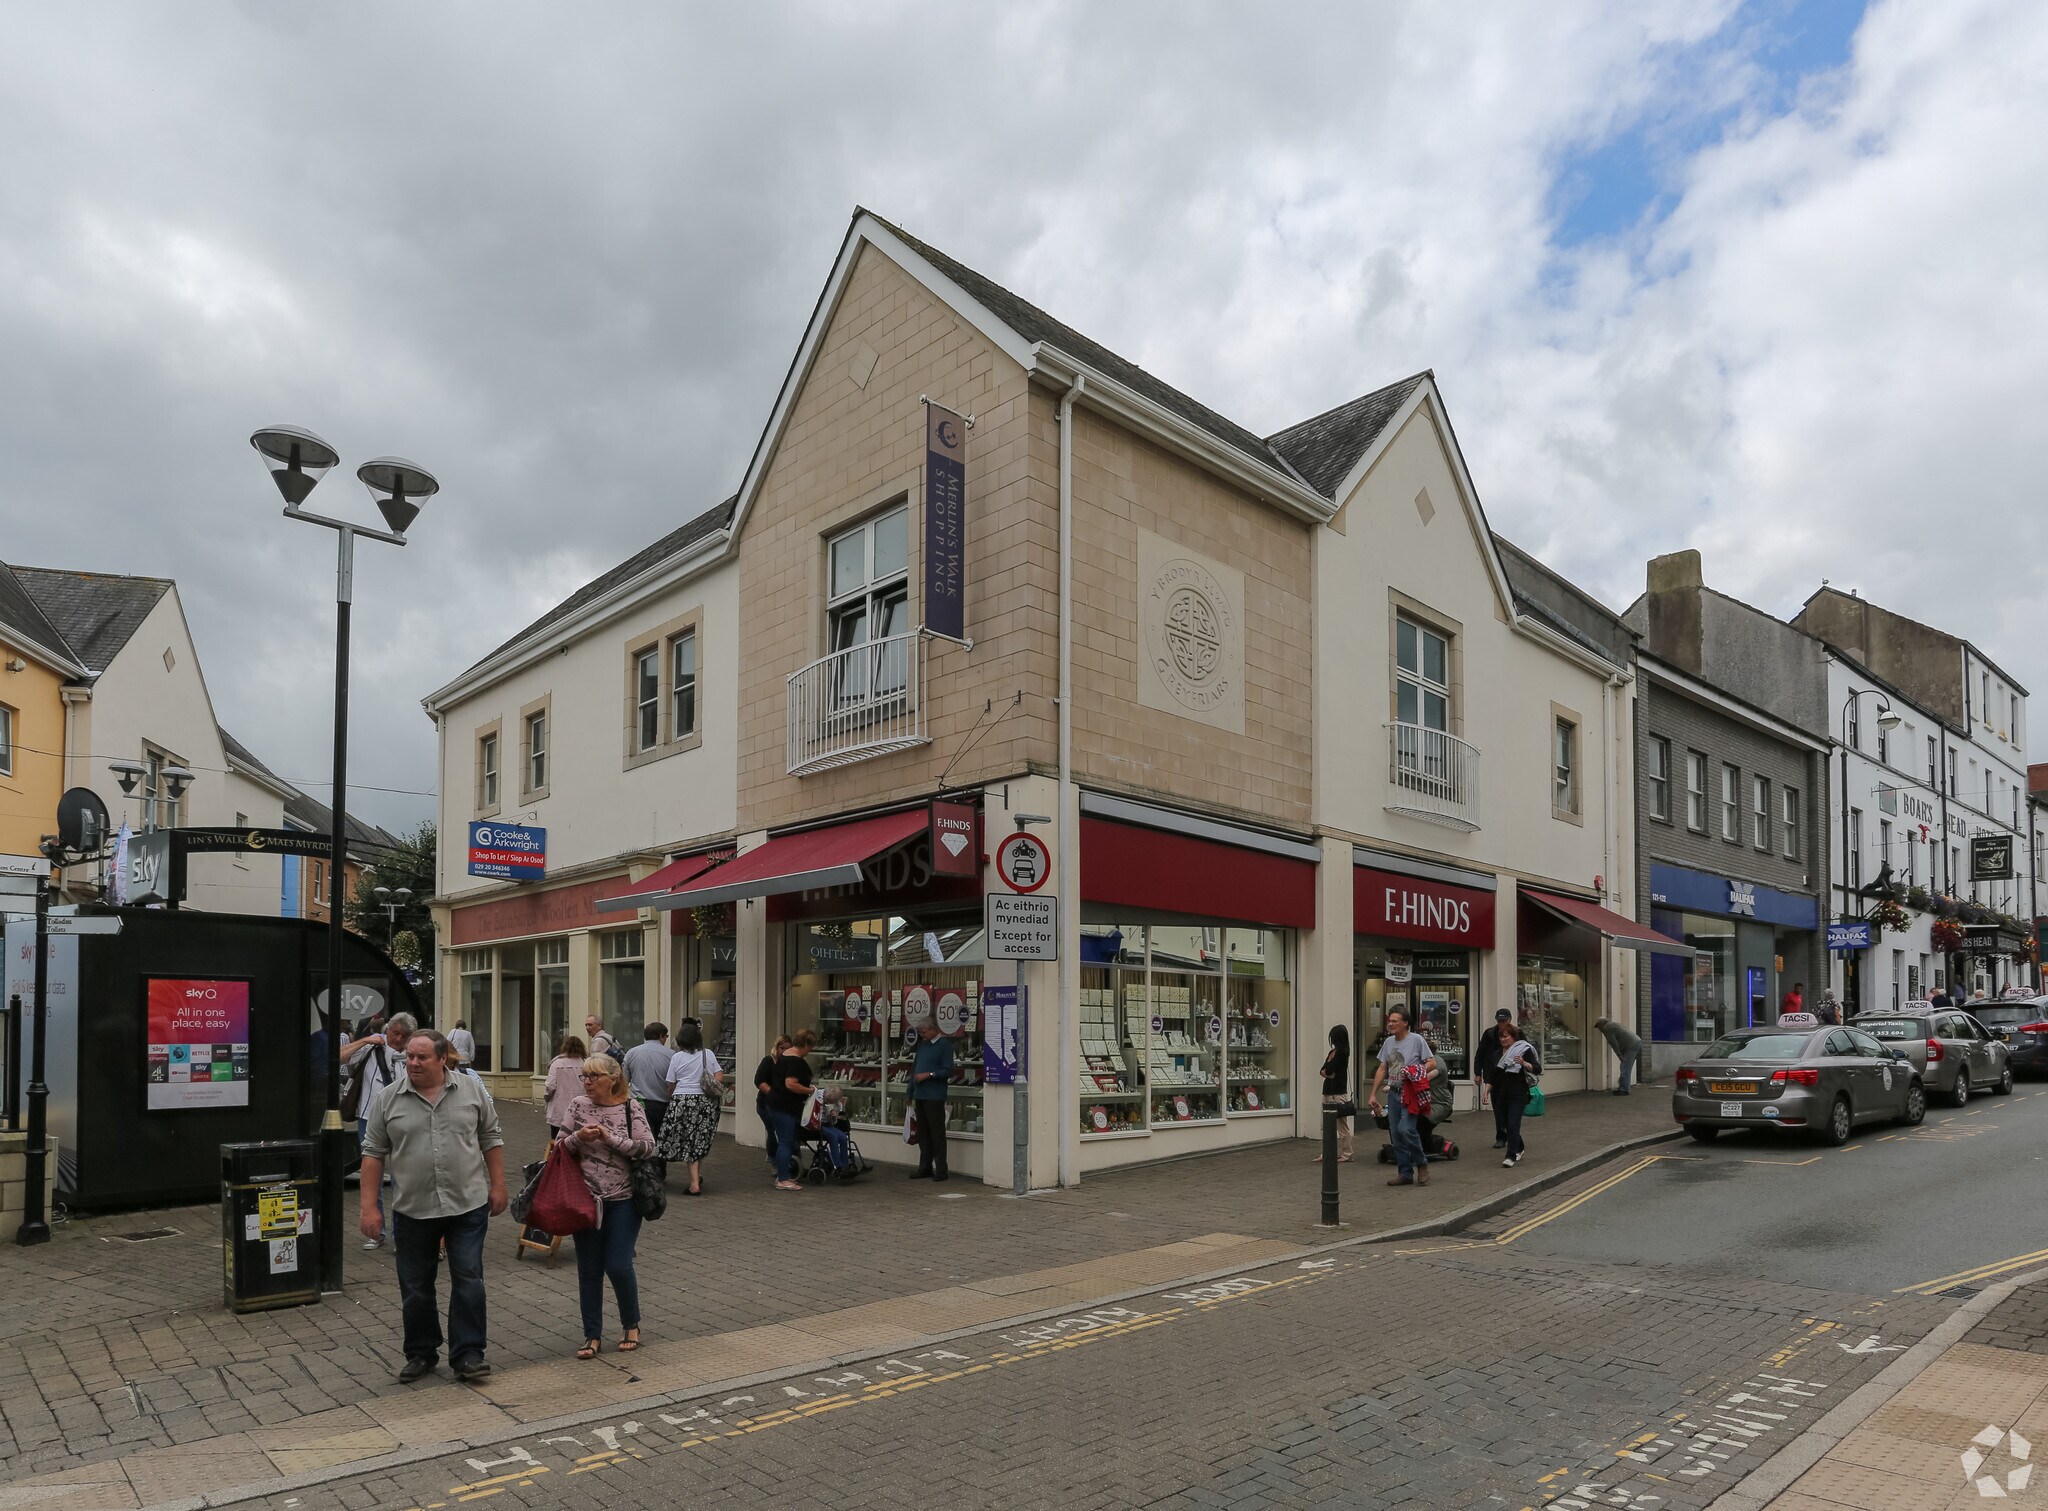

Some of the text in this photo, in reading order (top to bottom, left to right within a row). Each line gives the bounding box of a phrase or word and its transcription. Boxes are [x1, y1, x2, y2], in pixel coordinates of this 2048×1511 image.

[934, 468, 946, 594] SHOPPING
[947, 473, 959, 597] MERLIN'S WALK
[1903, 793, 1933, 825] BOAR'S
[1946, 811, 1967, 839] HEAD
[937, 817, 971, 831] F.HINDS
[214, 834, 244, 845] WALK
[267, 837, 295, 847] MAES
[493, 838, 540, 851] Arkwright
[475, 851, 489, 860] Shop
[497, 853, 506, 861] Let
[132, 844, 162, 891] sky
[1730, 890, 1755, 906] HALIFAX
[995, 900, 1050, 912] Ac eithrio
[1385, 887, 1470, 933] F.HINDS
[996, 914, 1049, 925] mynediad
[994, 930, 1052, 942] Except for
[1827, 932, 1868, 941] HALIFAX
[1973, 936, 1992, 947] HEAD
[1004, 944, 1041, 954] access
[1418, 958, 1460, 968] CITIZEN
[186, 988, 217, 1000] sky Q
[2008, 988, 2029, 996] TACSI
[176, 1007, 226, 1017] All in one
[906, 1000, 928, 1014] 50%
[1783, 1014, 1810, 1023] TACSI
[172, 1019, 231, 1030] place, easy
[152, 1045, 164, 1054] sky
[195, 1063, 208, 1071] sky
[1715, 1083, 1751, 1091] CE15 GCU
